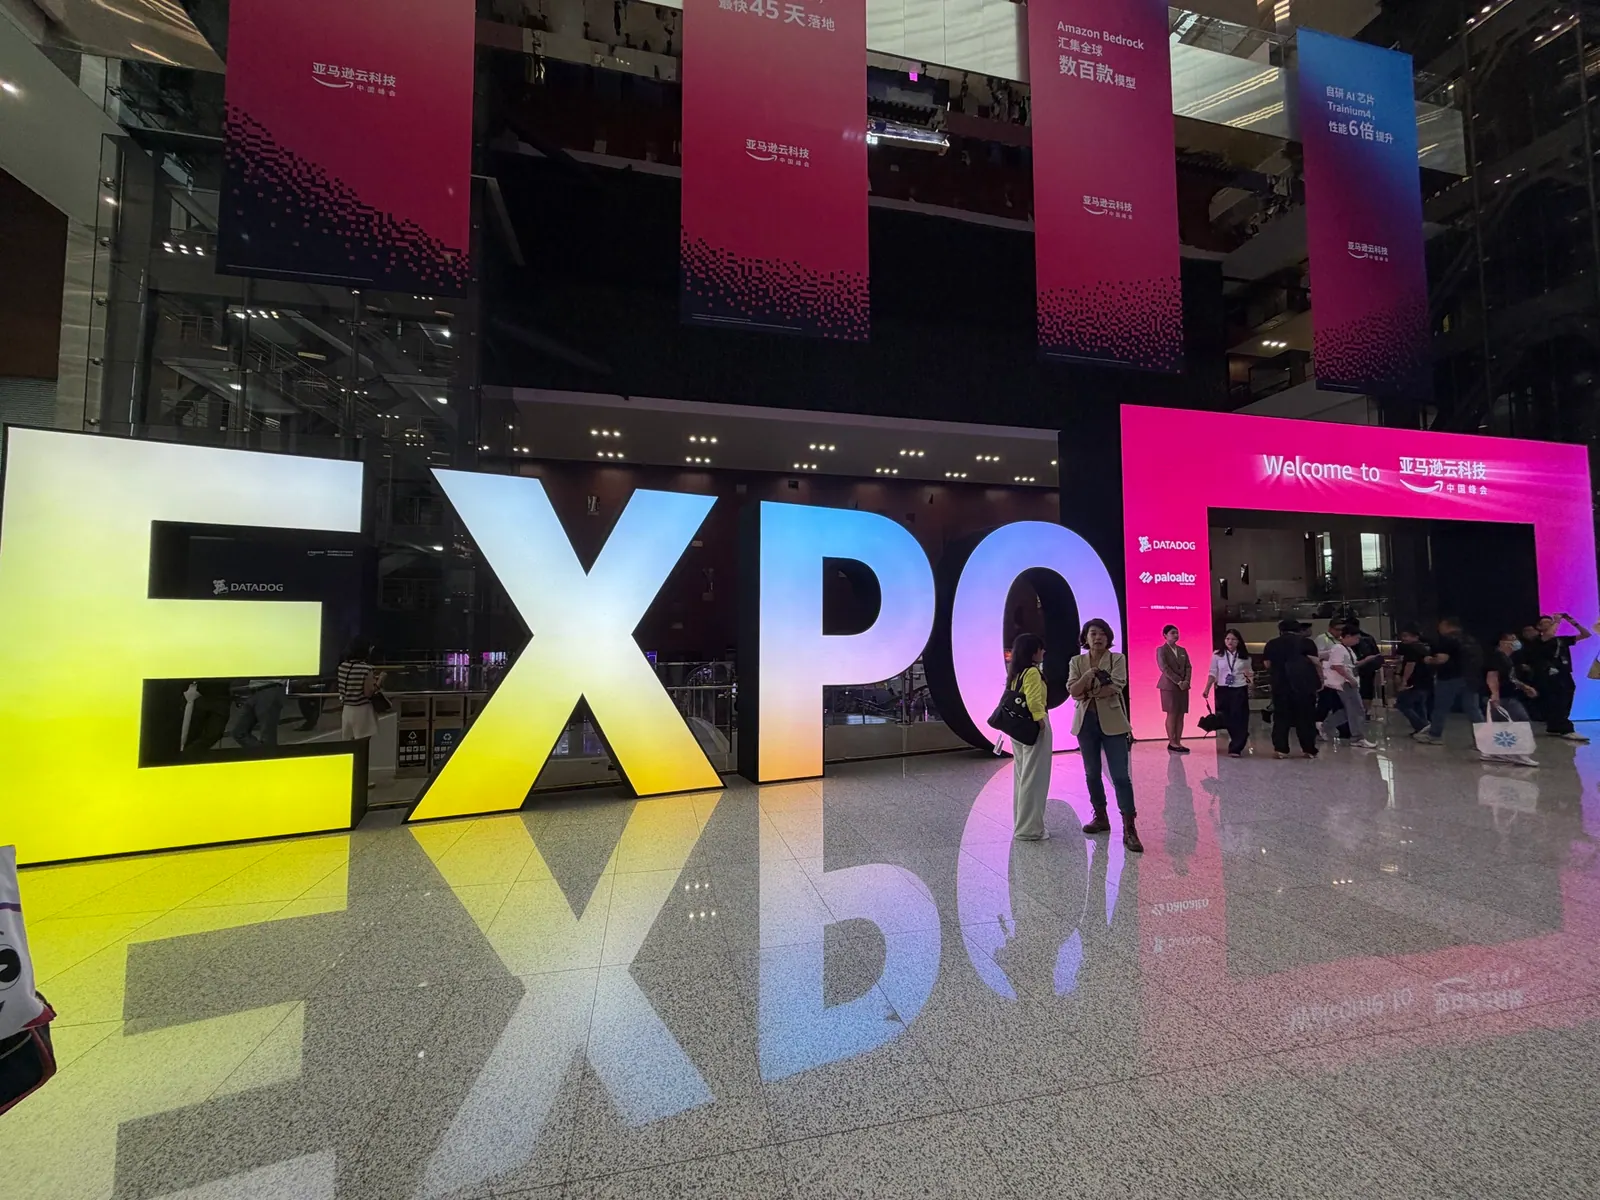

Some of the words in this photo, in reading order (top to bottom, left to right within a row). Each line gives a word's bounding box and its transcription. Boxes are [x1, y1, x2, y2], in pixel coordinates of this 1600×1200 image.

[1057, 20, 1101, 40] Amazon
[1103, 31, 1145, 50] Bedrock
[1058, 36, 1103, 57] 汇集全球
[312, 62, 396, 88] 亚马逊云科技
[1059, 54, 1137, 90] 数百款模型
[745, 138, 810, 160] 亚马逊云科技
[1083, 195, 1133, 212] 亚马逊云科技
[1263, 454, 1353, 481] Welcome
[1361, 463, 1380, 482] to
[1399, 456, 1487, 480] 亚马逊云科技
[1446, 483, 1488, 496] 中国峰会
[1153, 540, 1196, 550] DATADOG
[230, 582, 284, 592] DATADOG
[1154, 571, 1196, 584] paloalto
[0, 426, 1122, 866] EXPO
